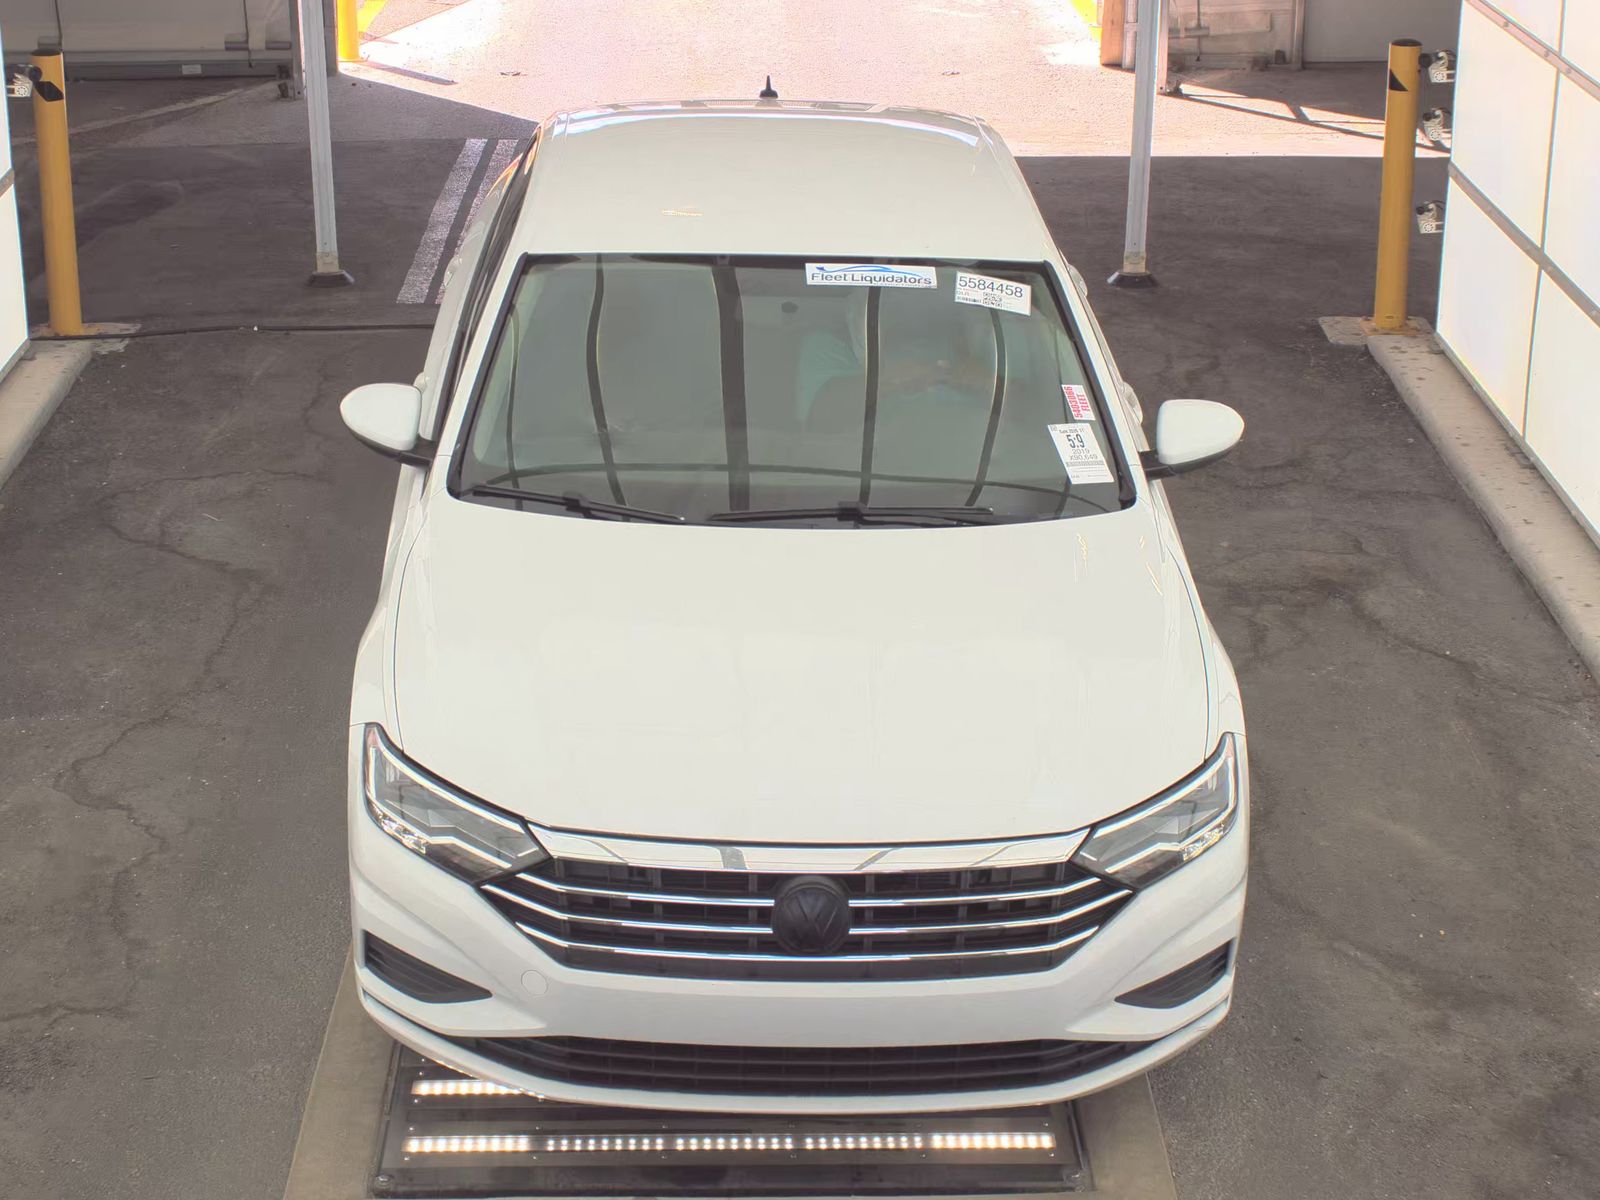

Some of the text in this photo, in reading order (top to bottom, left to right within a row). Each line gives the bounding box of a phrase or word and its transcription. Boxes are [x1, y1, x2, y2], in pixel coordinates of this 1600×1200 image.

[811, 272, 848, 282] Fleet
[851, 273, 932, 286] Liquidators
[958, 275, 1023, 298] 5584458
